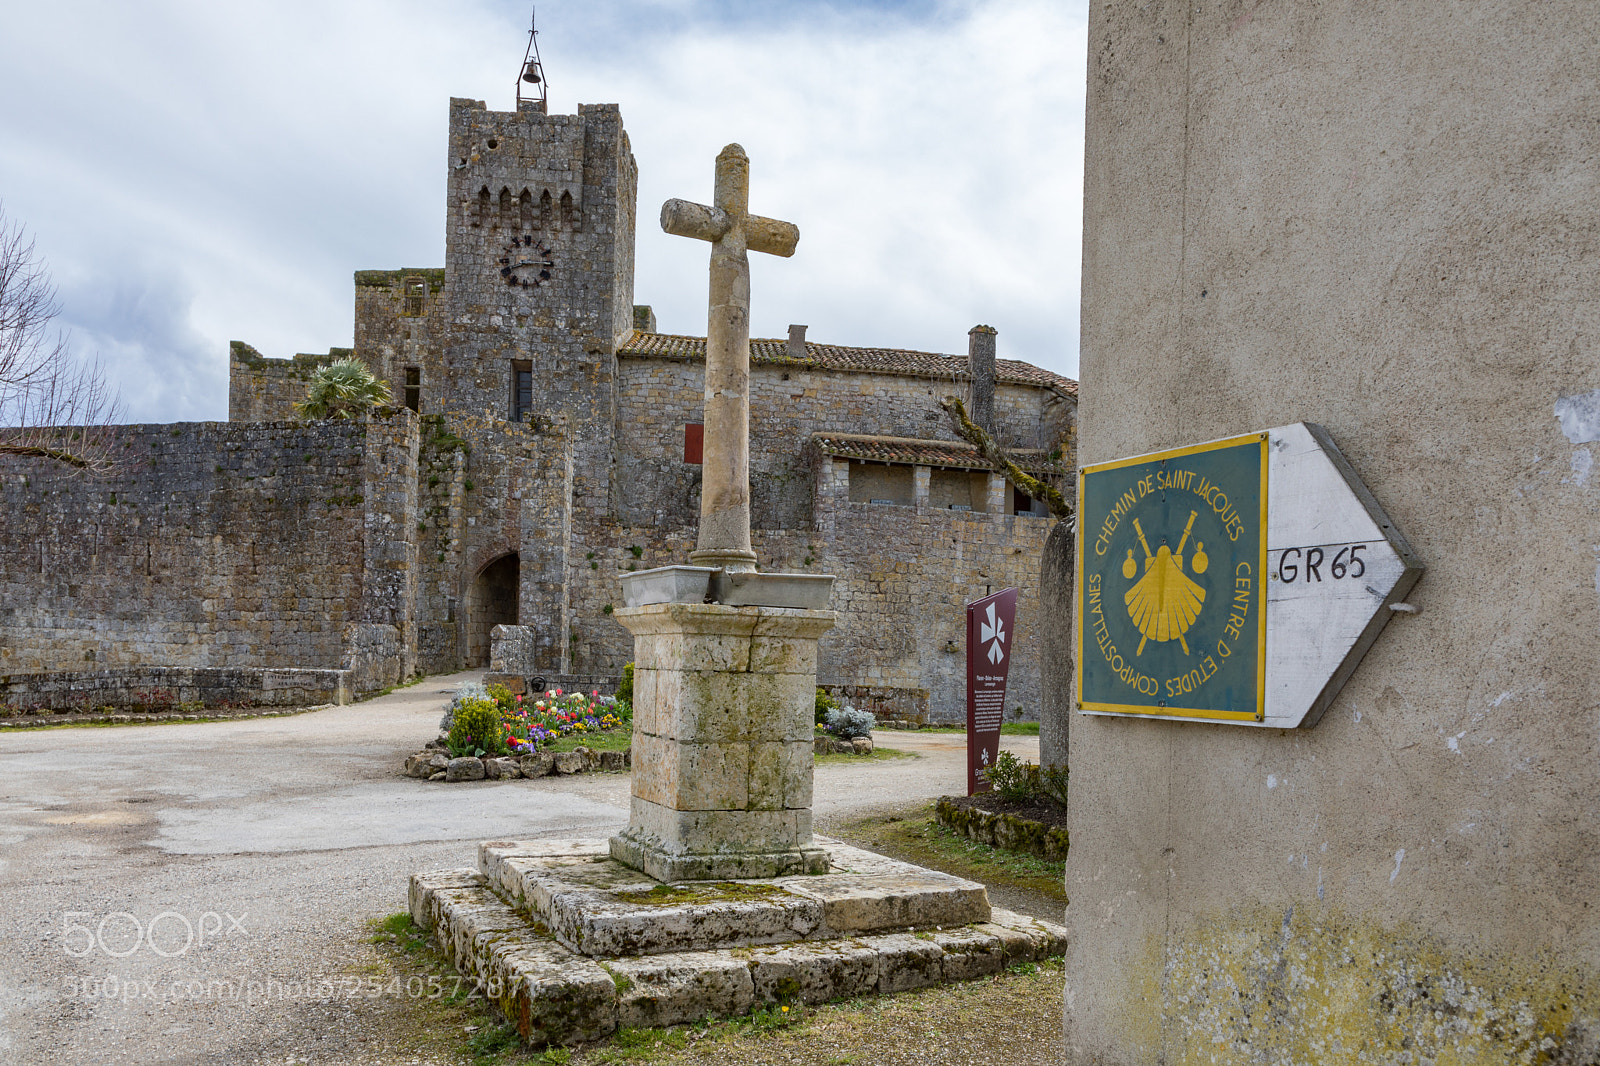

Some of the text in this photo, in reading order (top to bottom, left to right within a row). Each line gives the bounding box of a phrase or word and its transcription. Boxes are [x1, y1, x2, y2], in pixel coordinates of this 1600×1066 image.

[1095, 469, 1245, 556] CHEMIN DE SAINT JACQUES
[1088, 573, 1159, 696] COMPOSTELLANES
[1224, 561, 1252, 641] CENTRE
